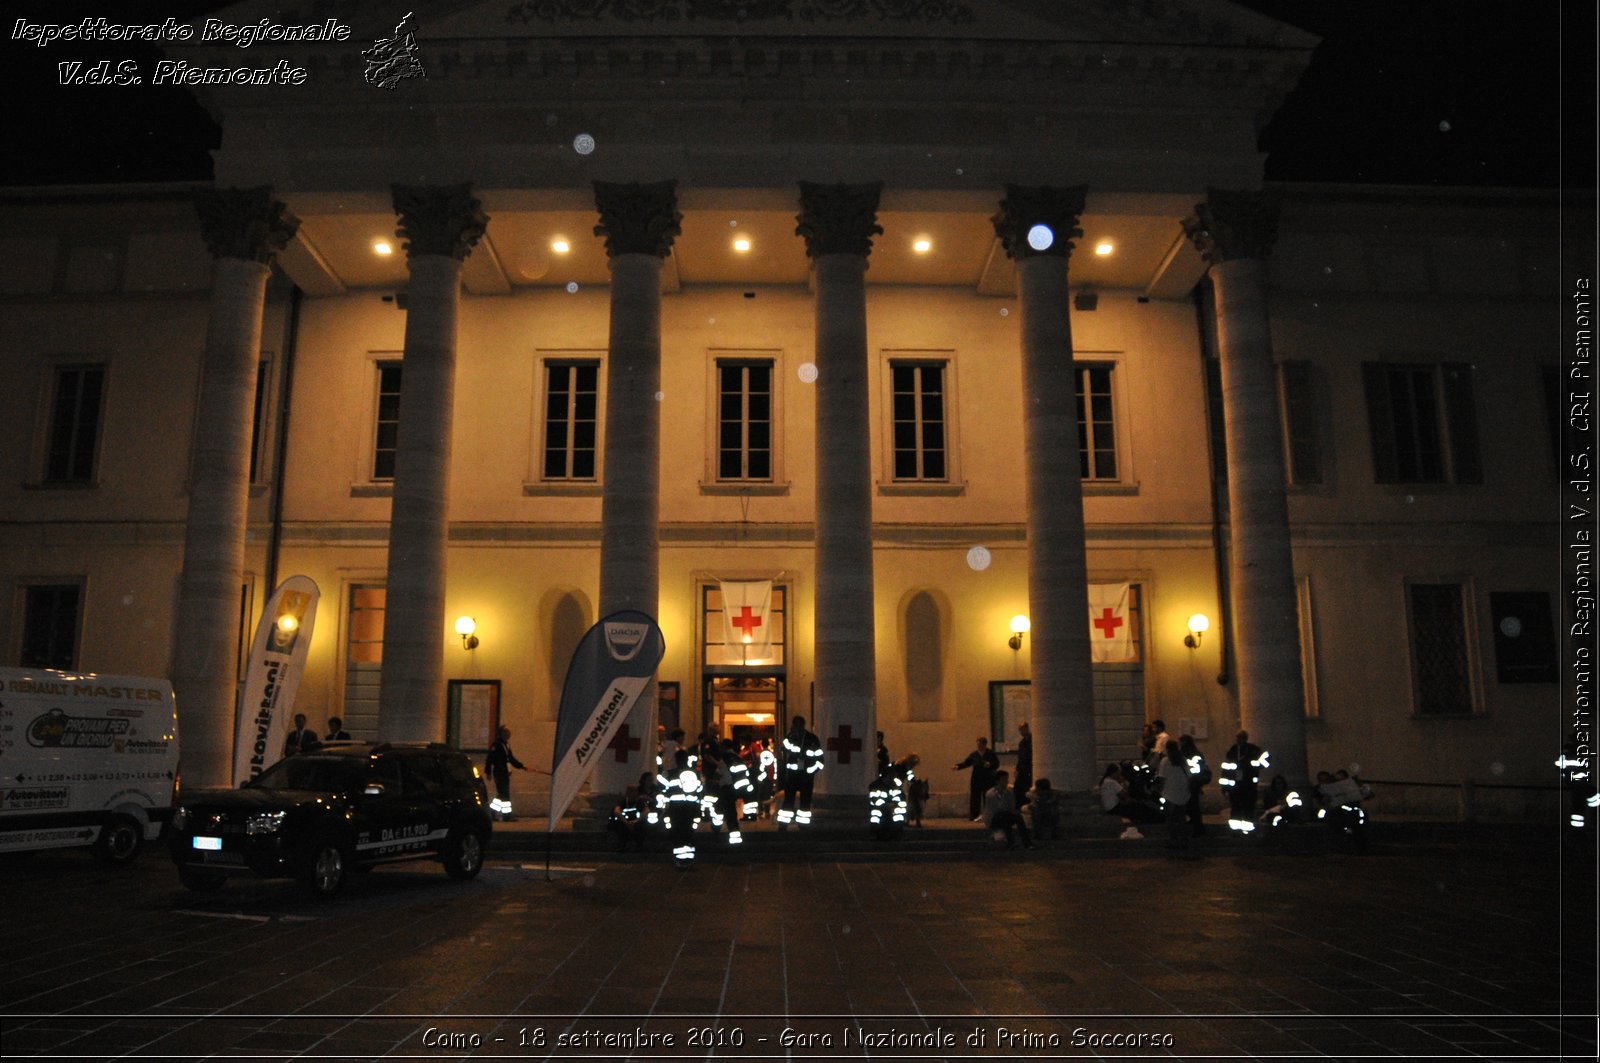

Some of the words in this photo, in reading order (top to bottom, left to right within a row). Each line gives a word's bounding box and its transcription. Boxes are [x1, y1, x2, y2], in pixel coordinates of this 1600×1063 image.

[610, 628, 640, 637] DACIA
[9, 680, 68, 695] RENAULT
[74, 684, 164, 701] MASTER
[65, 718, 108, 732] PROVAMI
[108, 720, 128, 733] PER
[241, 659, 280, 788] utovittoni
[574, 688, 625, 764] Autovittoni
[60, 732, 78, 745] UN
[78, 733, 114, 746] GIORNO
[5, 787, 67, 800] Autovittoni
[381, 828, 394, 841] DA
